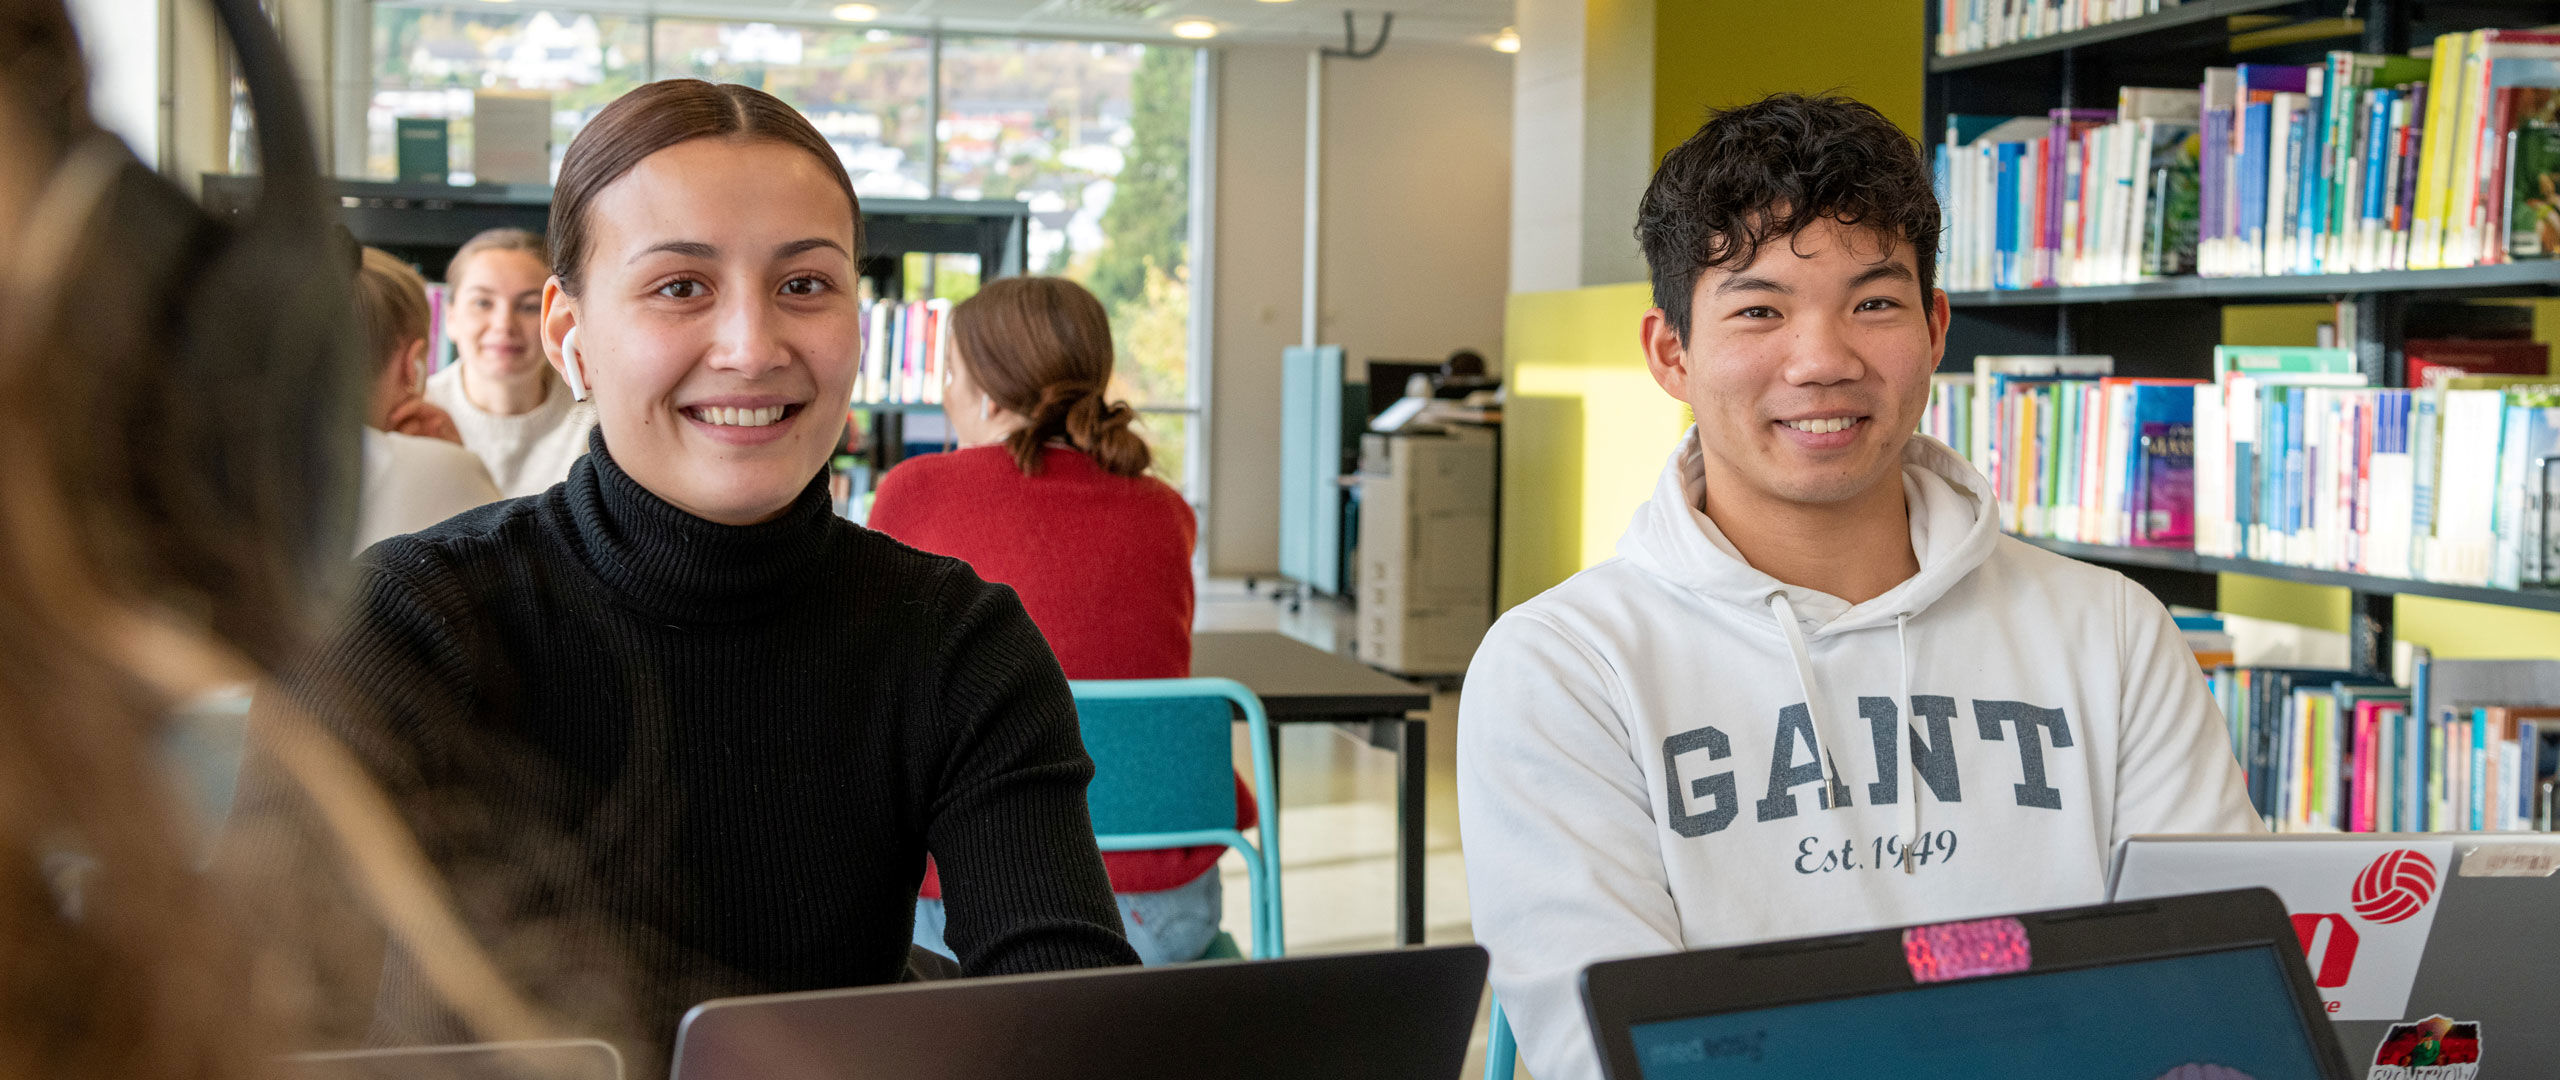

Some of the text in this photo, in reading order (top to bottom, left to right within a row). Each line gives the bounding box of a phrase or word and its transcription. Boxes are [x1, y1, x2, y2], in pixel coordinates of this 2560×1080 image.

[1662, 694, 2075, 839] GANT
[1794, 829, 1958, 875] Est. 1949
